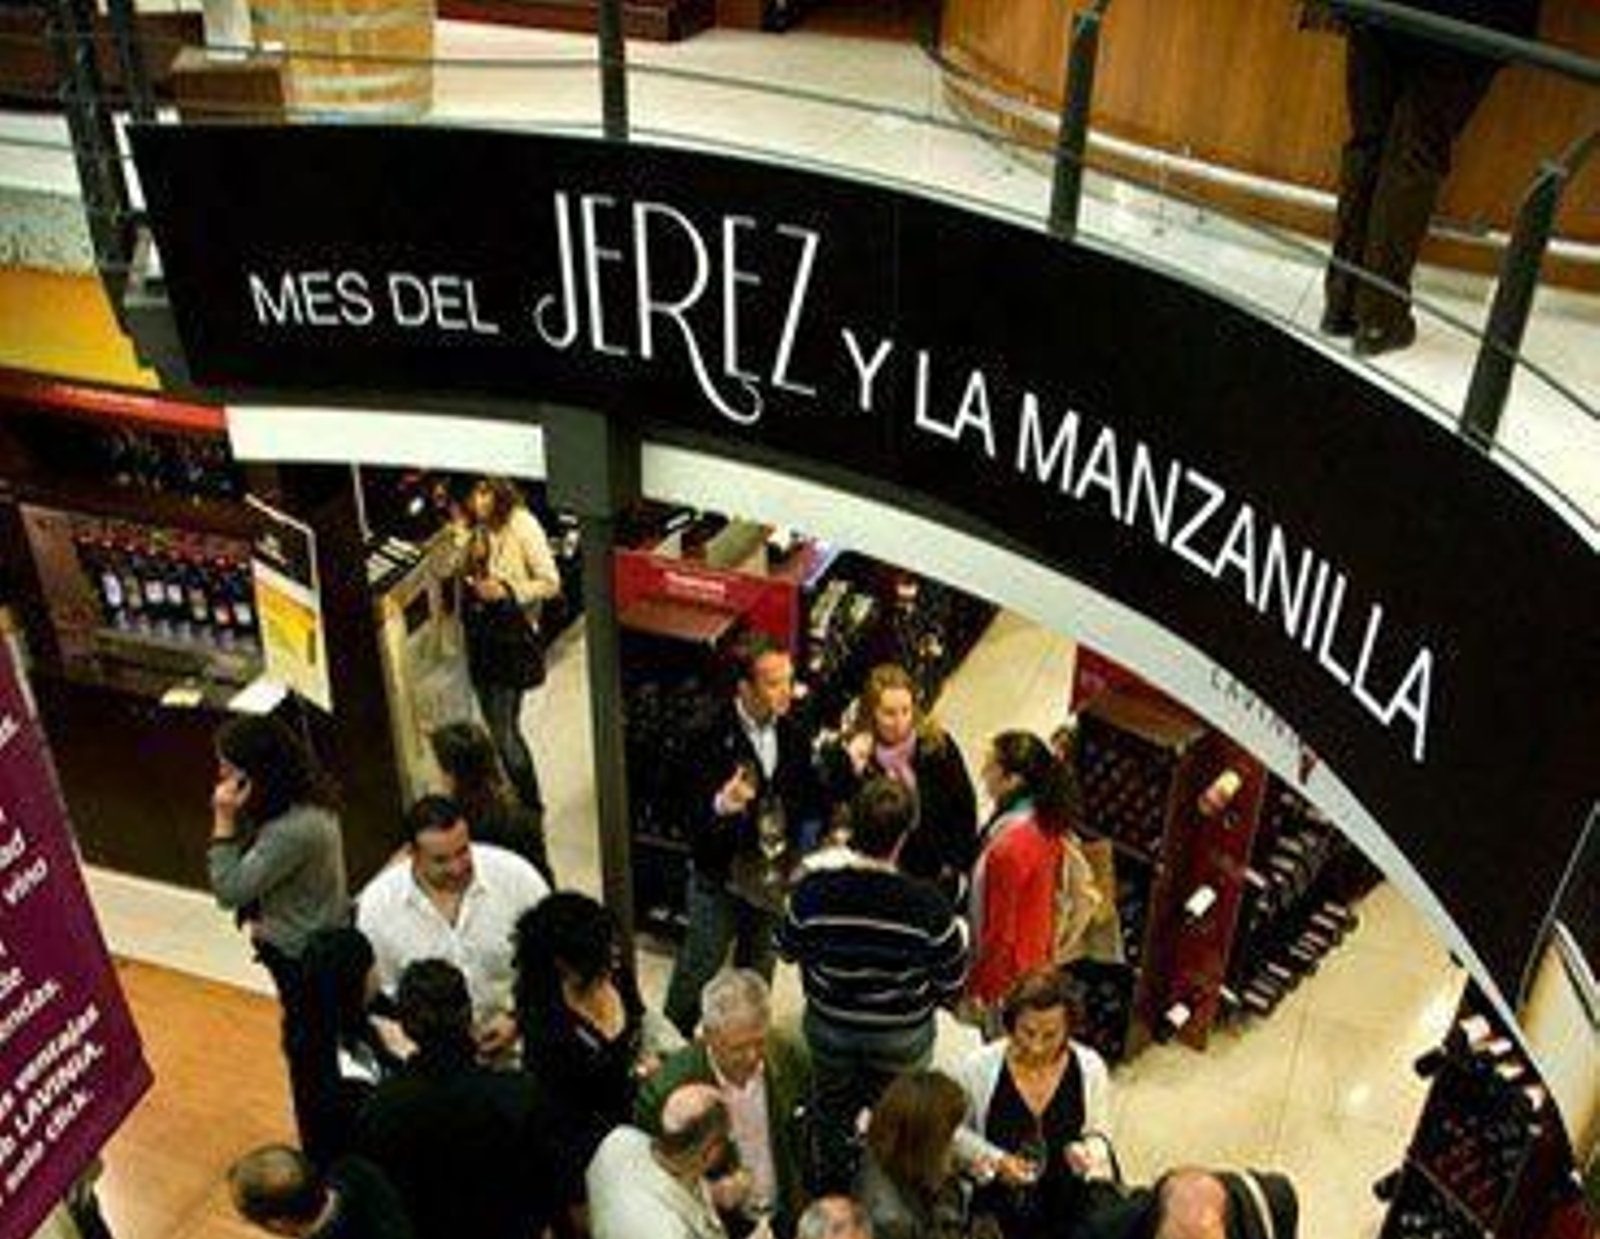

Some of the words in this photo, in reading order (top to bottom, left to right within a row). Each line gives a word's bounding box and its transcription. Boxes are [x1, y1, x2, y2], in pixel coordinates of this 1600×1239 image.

[250, 271, 374, 325] MES
[388, 274, 500, 334] DEL
[535, 191, 821, 425] JEREZ
[841, 328, 893, 411] Y
[915, 350, 996, 457] LA
[1016, 392, 1436, 763] MANZANILLA
[2, 856, 48, 904] vino
